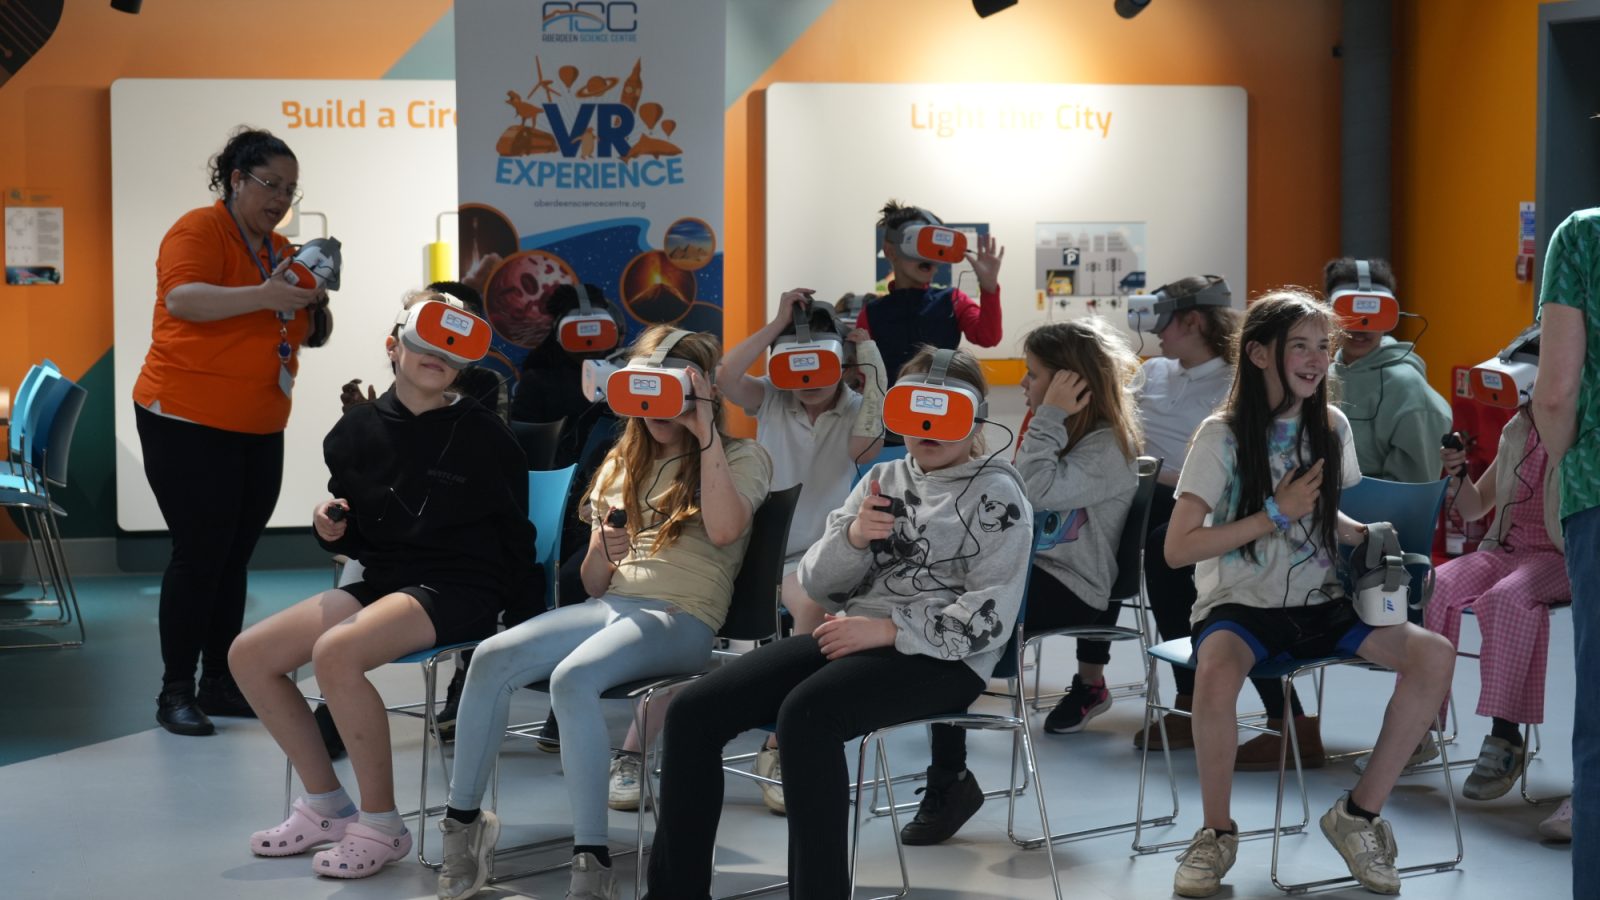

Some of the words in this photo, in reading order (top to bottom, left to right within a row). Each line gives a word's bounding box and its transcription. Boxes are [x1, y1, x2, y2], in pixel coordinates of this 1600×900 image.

[542, 1, 638, 32] ASC
[542, 33, 578, 42] ABERDEEN
[580, 33, 609, 42] SCIENCE
[611, 33, 638, 42] CENTRE
[282, 100, 366, 129] Build
[378, 107, 396, 129] a
[1056, 104, 1113, 139] City
[542, 103, 636, 158] VR
[495, 157, 684, 189] EXPERIENCE
[534, 199, 646, 209] aberdeensciencecentre.org
